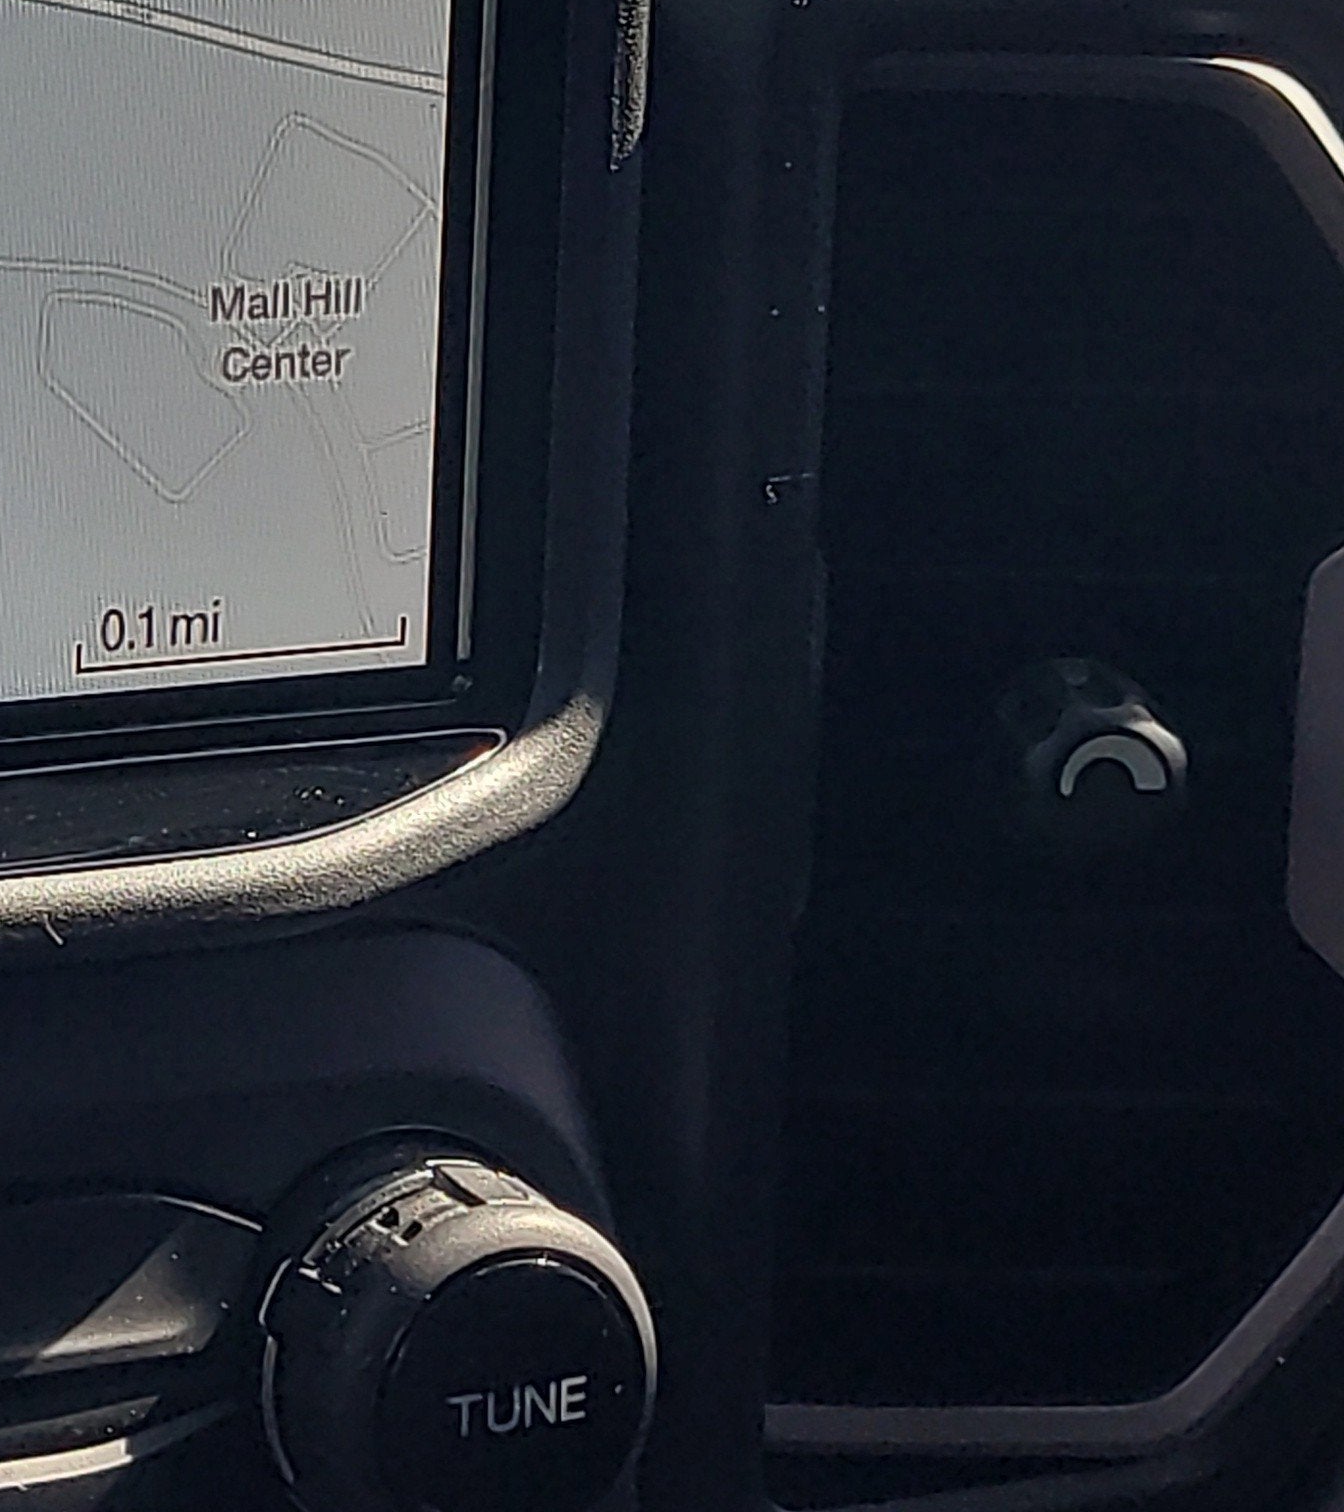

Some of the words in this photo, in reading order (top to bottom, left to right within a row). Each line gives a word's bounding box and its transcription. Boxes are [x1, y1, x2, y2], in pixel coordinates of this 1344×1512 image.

[211, 281, 290, 322] Mall
[303, 277, 363, 317] Hill
[221, 344, 352, 381] Center
[100, 607, 156, 650] 0.1
[171, 600, 222, 644] mi
[445, 1374, 588, 1438] TUNE
